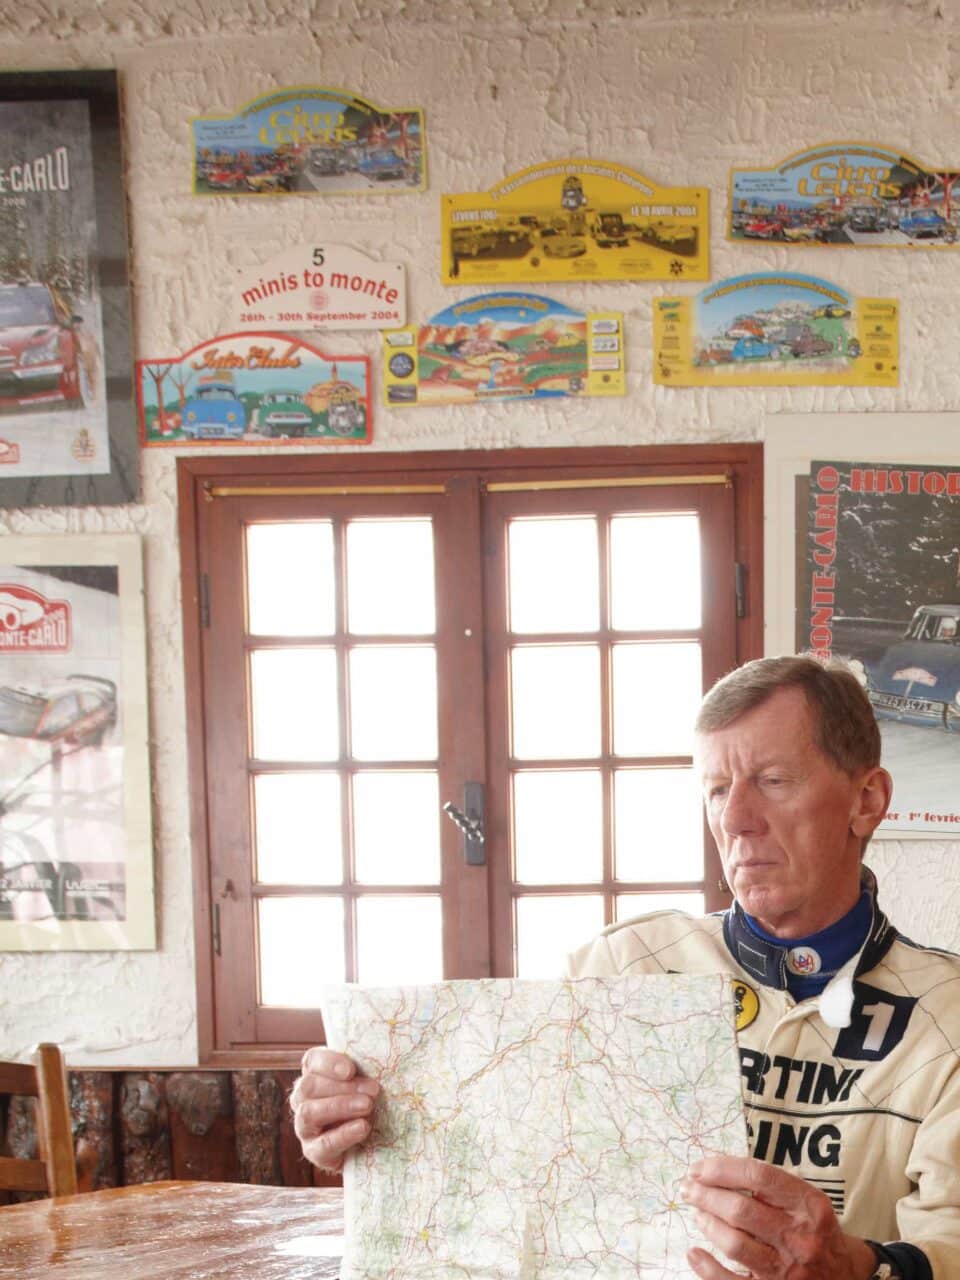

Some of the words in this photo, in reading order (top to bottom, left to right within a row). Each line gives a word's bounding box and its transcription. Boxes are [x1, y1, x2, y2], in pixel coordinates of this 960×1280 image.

[312, 248, 325, 267] 5
[241, 272, 298, 307] minis
[303, 268, 324, 288] to
[329, 272, 399, 304] monte
[306, 311, 367, 324] September
[861, 1001, 896, 1052] 1
[747, 1120, 842, 1168] ING
